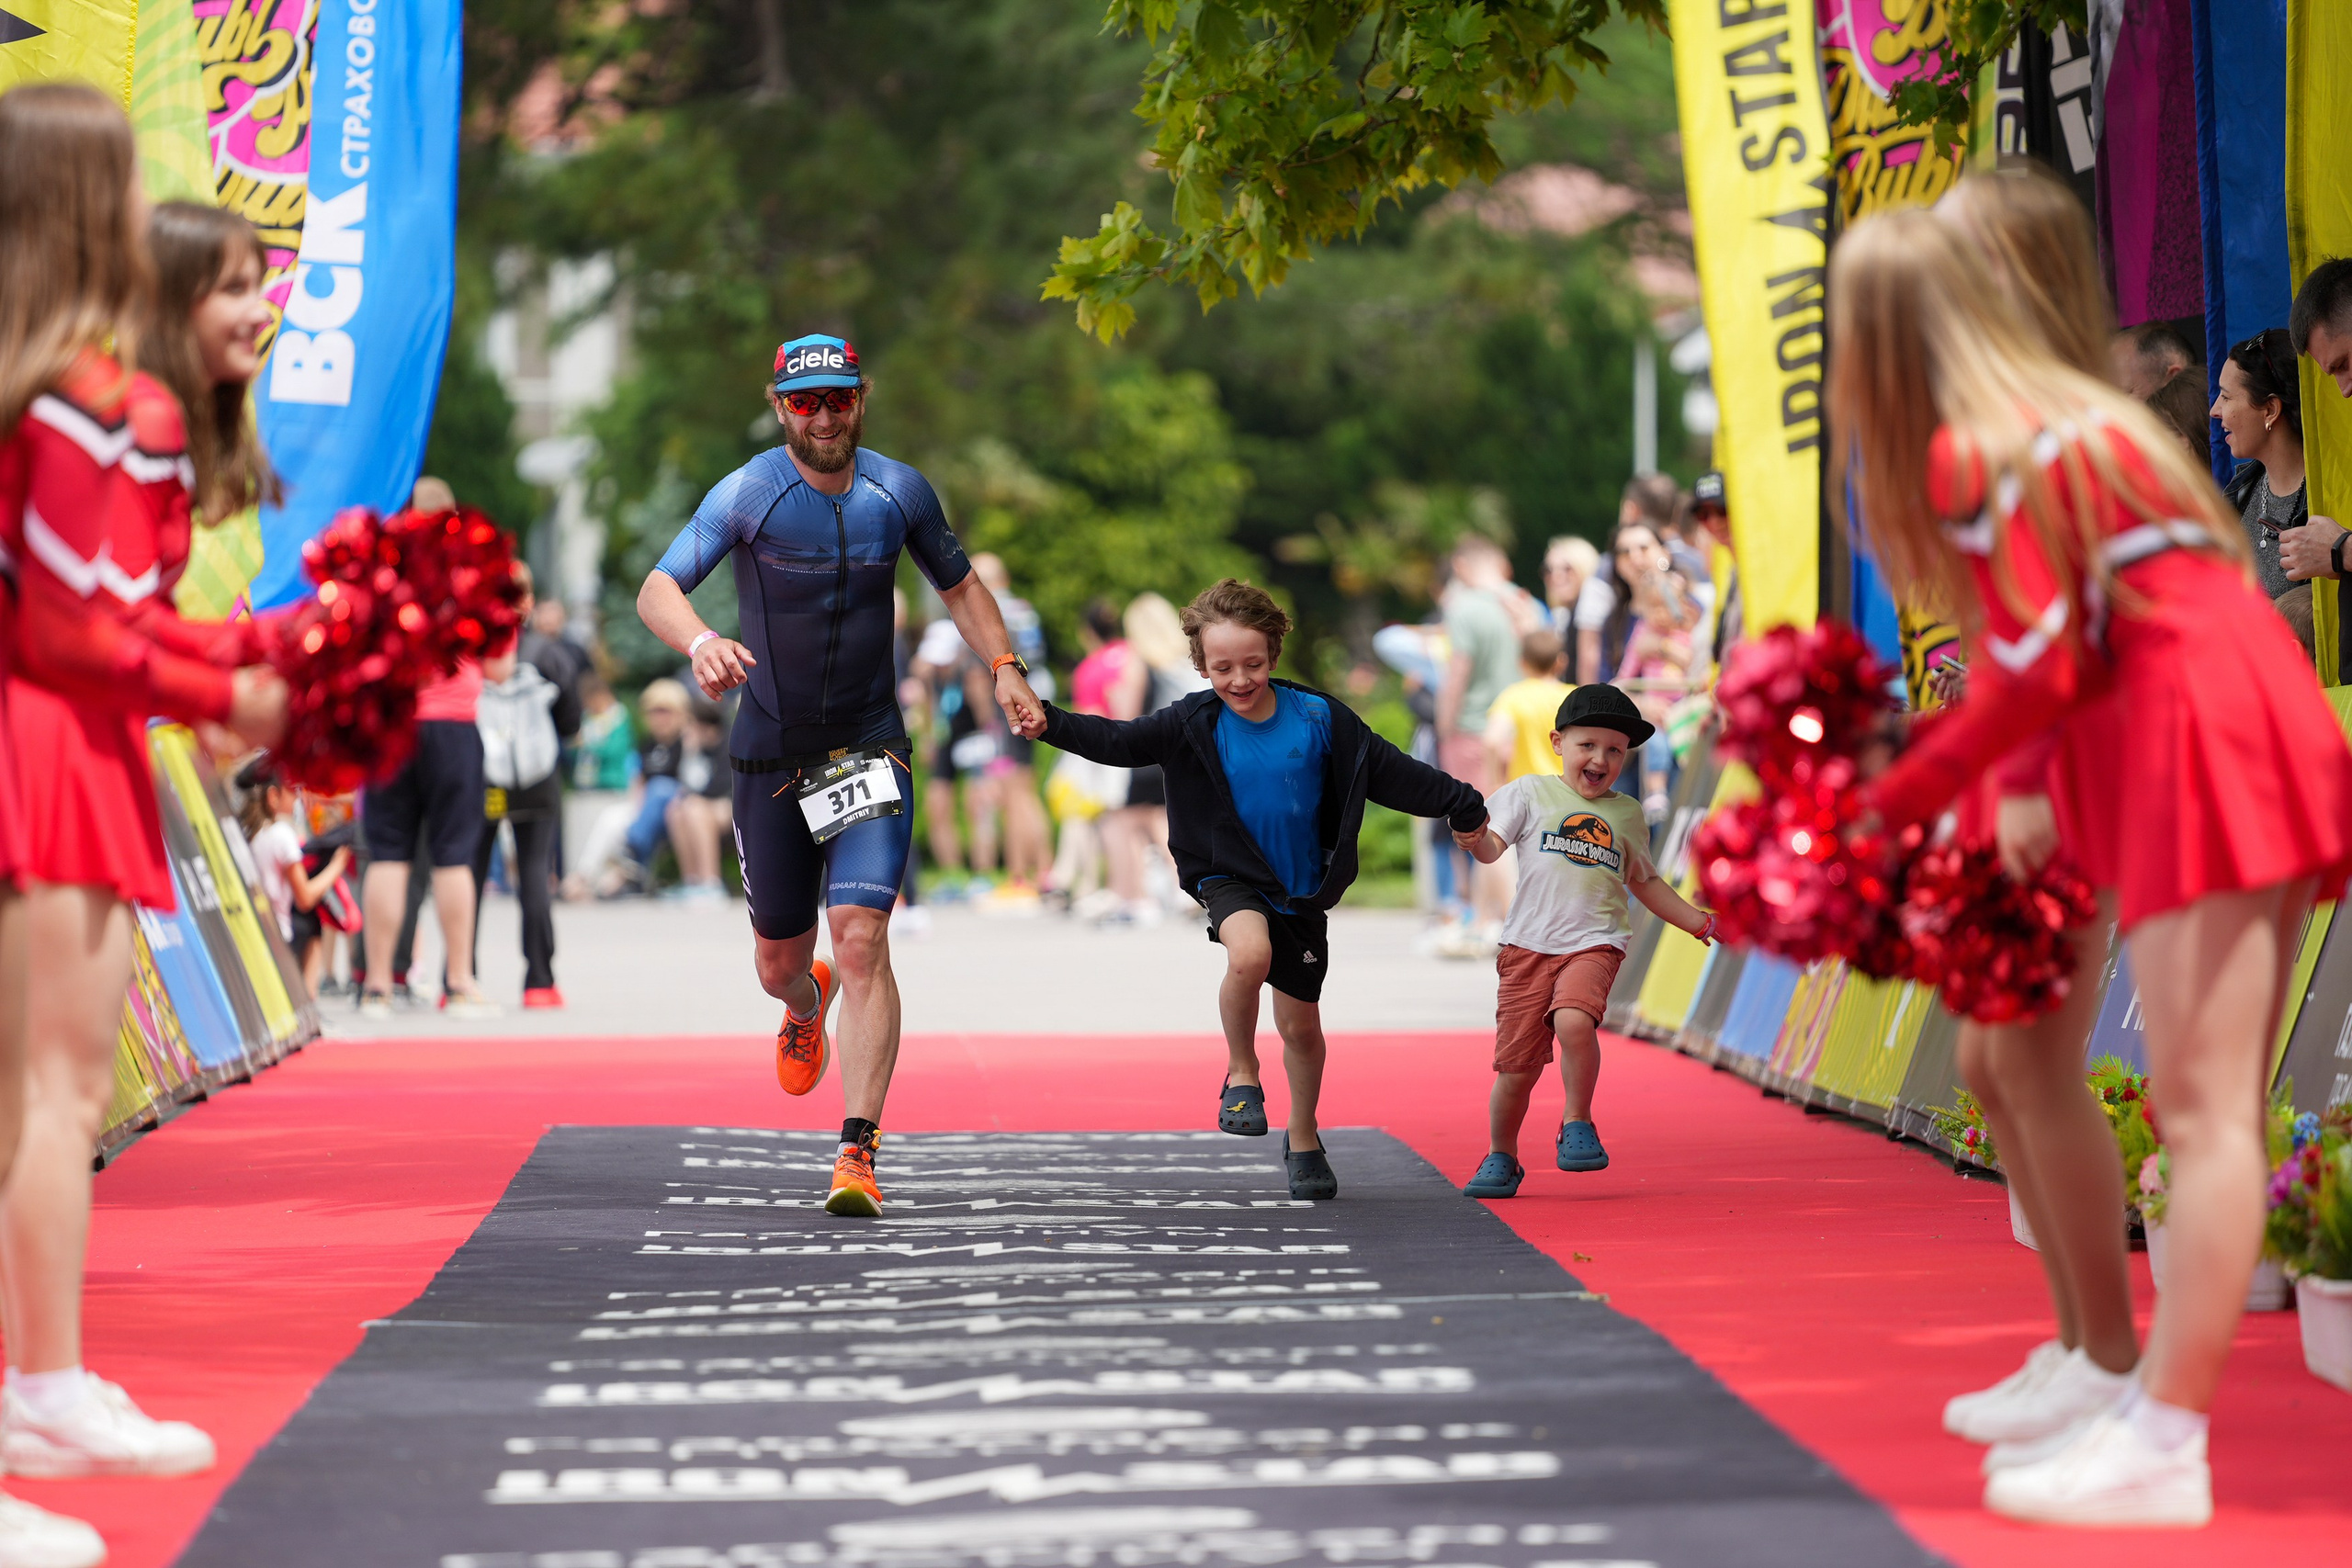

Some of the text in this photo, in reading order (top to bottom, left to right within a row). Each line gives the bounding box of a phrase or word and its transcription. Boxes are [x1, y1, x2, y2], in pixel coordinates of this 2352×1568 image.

[268, 181, 368, 406] ВСК
[786, 348, 844, 374] ciele
[824, 766, 838, 777] IRON
[841, 760, 855, 770] STAR
[828, 778, 872, 816] 371
[842, 807, 870, 825] DMITRIY
[1544, 834, 1619, 867] JURASSIC WORLD
[641, 1243, 1350, 1253] IRON STAR
